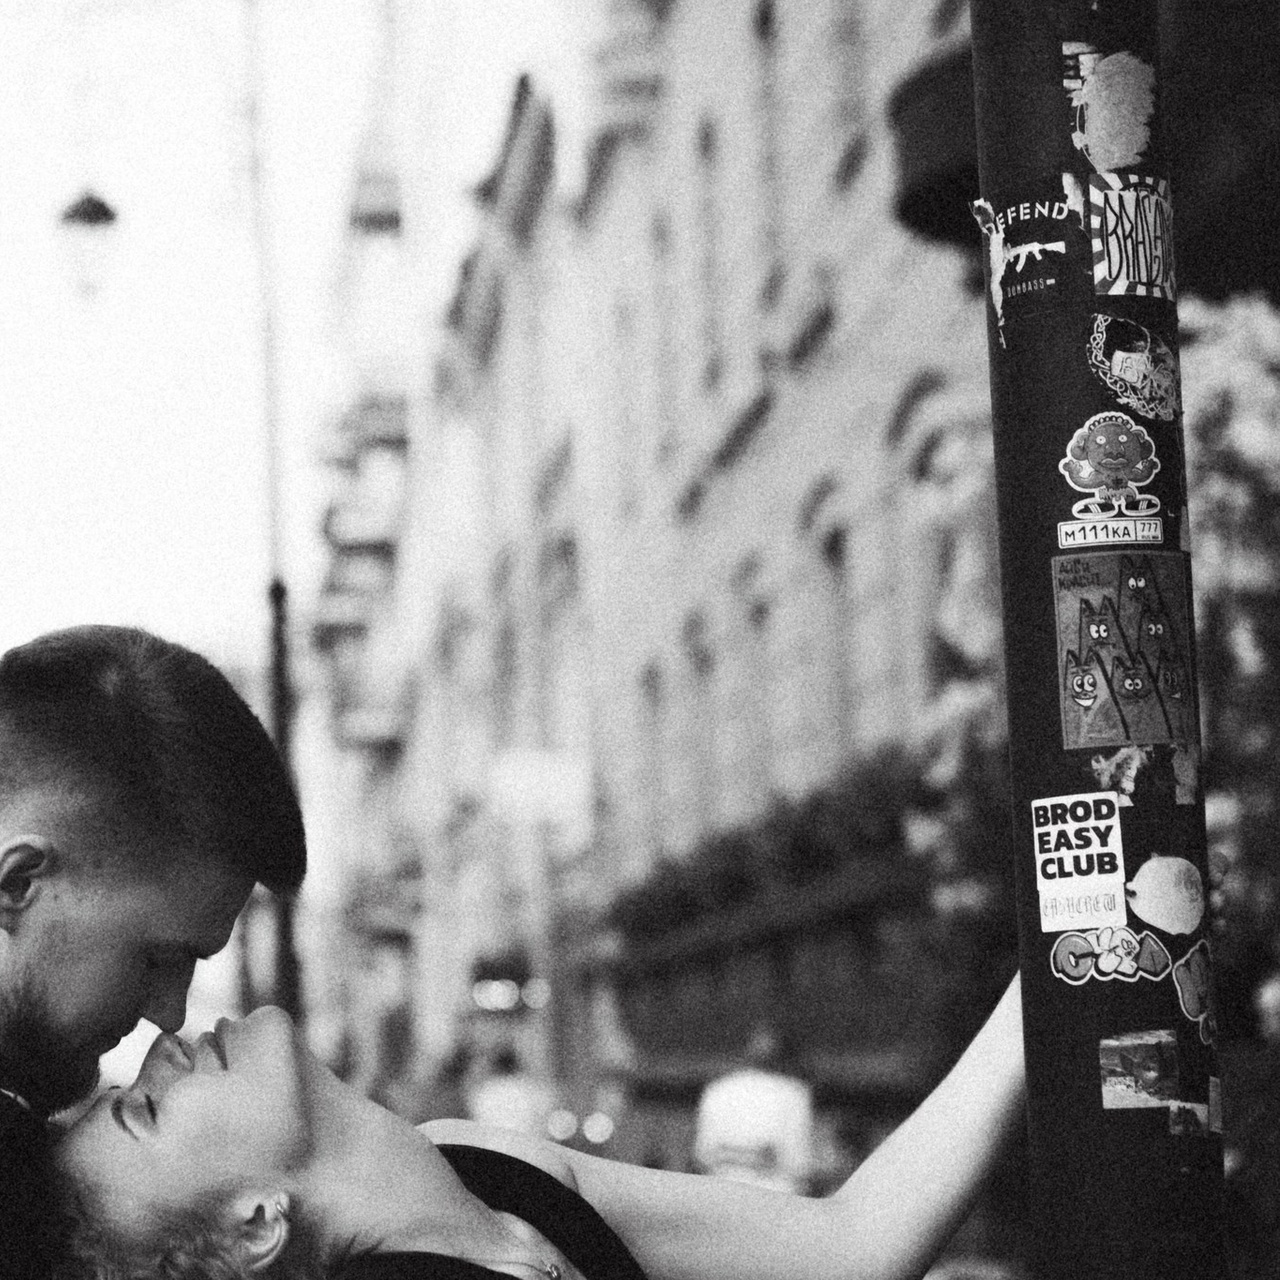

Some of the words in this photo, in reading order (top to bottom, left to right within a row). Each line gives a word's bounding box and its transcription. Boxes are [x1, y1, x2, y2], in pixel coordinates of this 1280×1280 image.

[1140, 522, 1158, 533] 777
[1033, 798, 1116, 828] BROD
[1037, 824, 1114, 854] EASY
[1040, 851, 1119, 880] CLUB
